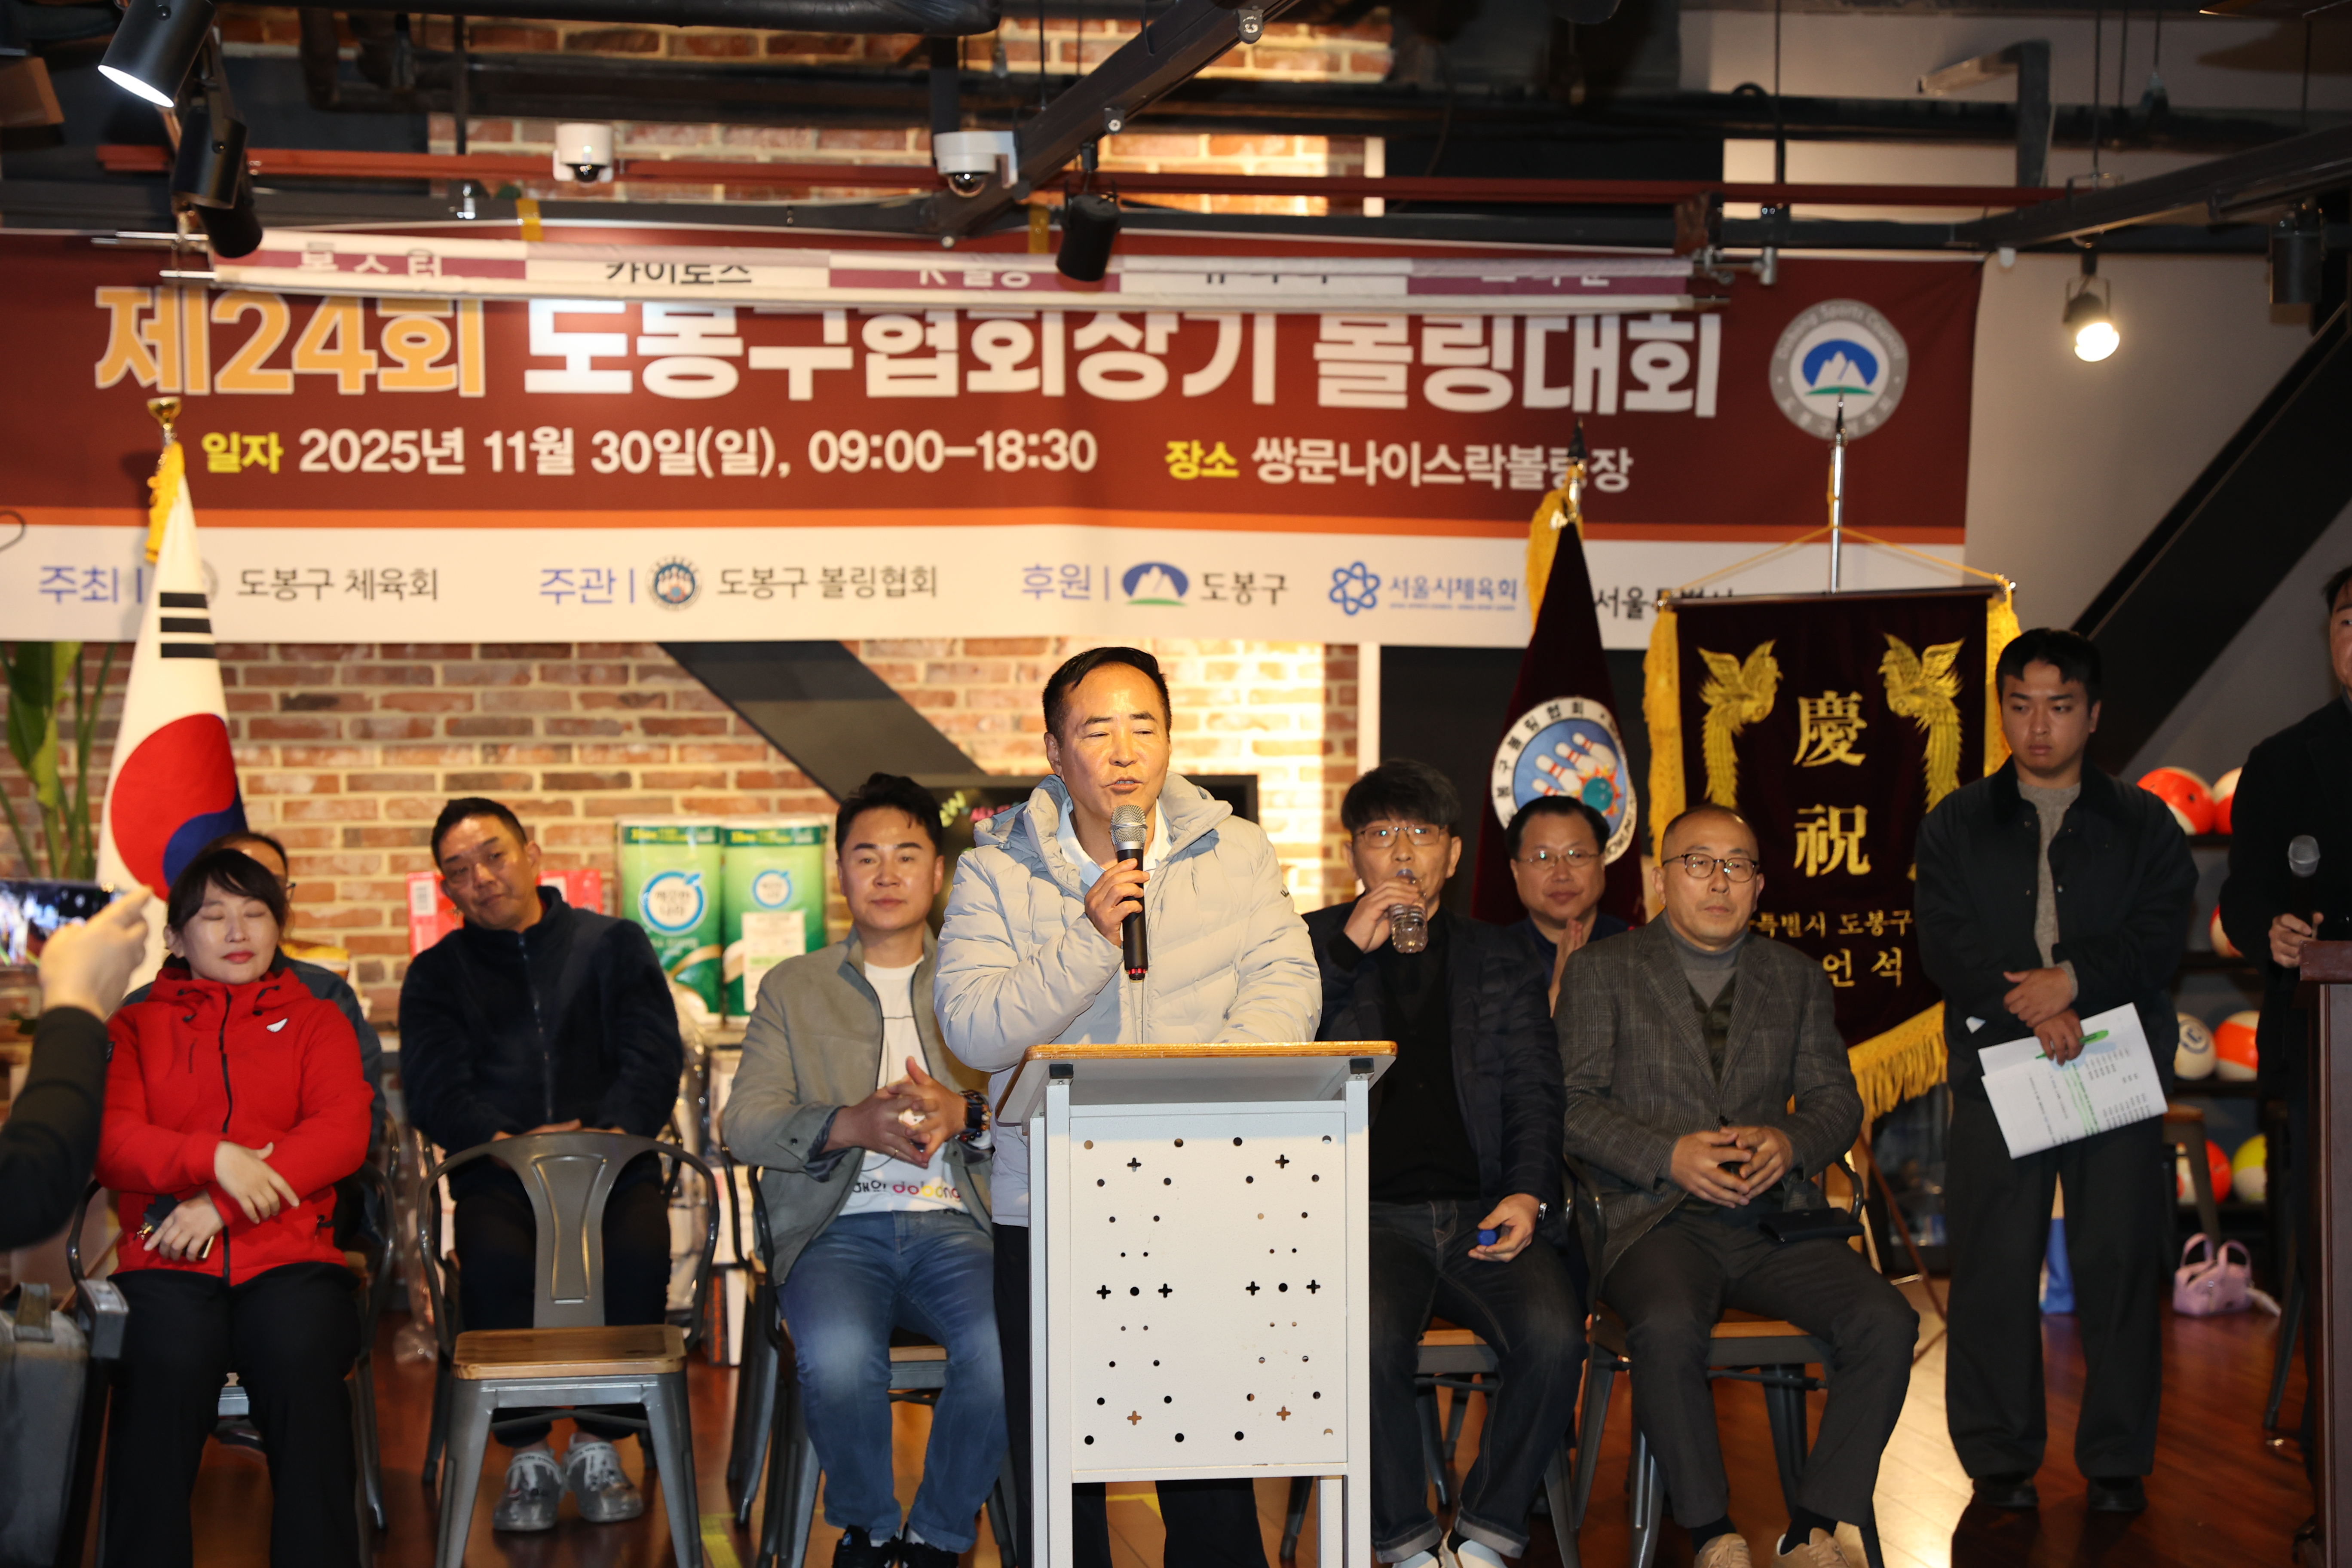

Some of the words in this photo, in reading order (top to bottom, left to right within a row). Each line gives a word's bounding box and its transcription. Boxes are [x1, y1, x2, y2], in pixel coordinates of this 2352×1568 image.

[94, 285, 486, 397] 제24회
[201, 432, 285, 474] 일자
[298, 426, 467, 475] 2025년
[484, 426, 575, 476] 11월
[591, 426, 791, 479] 30일(일),
[1165, 440, 1239, 481] 장소
[39, 566, 119, 605] 주최
[237, 567, 334, 601] 도봉구
[344, 567, 439, 602] 체육회
[539, 567, 616, 606] 주관
[717, 567, 809, 599] 도봉구
[818, 565, 938, 597] 볼링협회
[1020, 563, 1091, 601] 후원
[1200, 571, 1289, 605] 도봉구
[1792, 689, 1871, 878] 慶祝
[1748, 911, 1827, 939] 특별시
[1837, 909, 1914, 937] 도봉구
